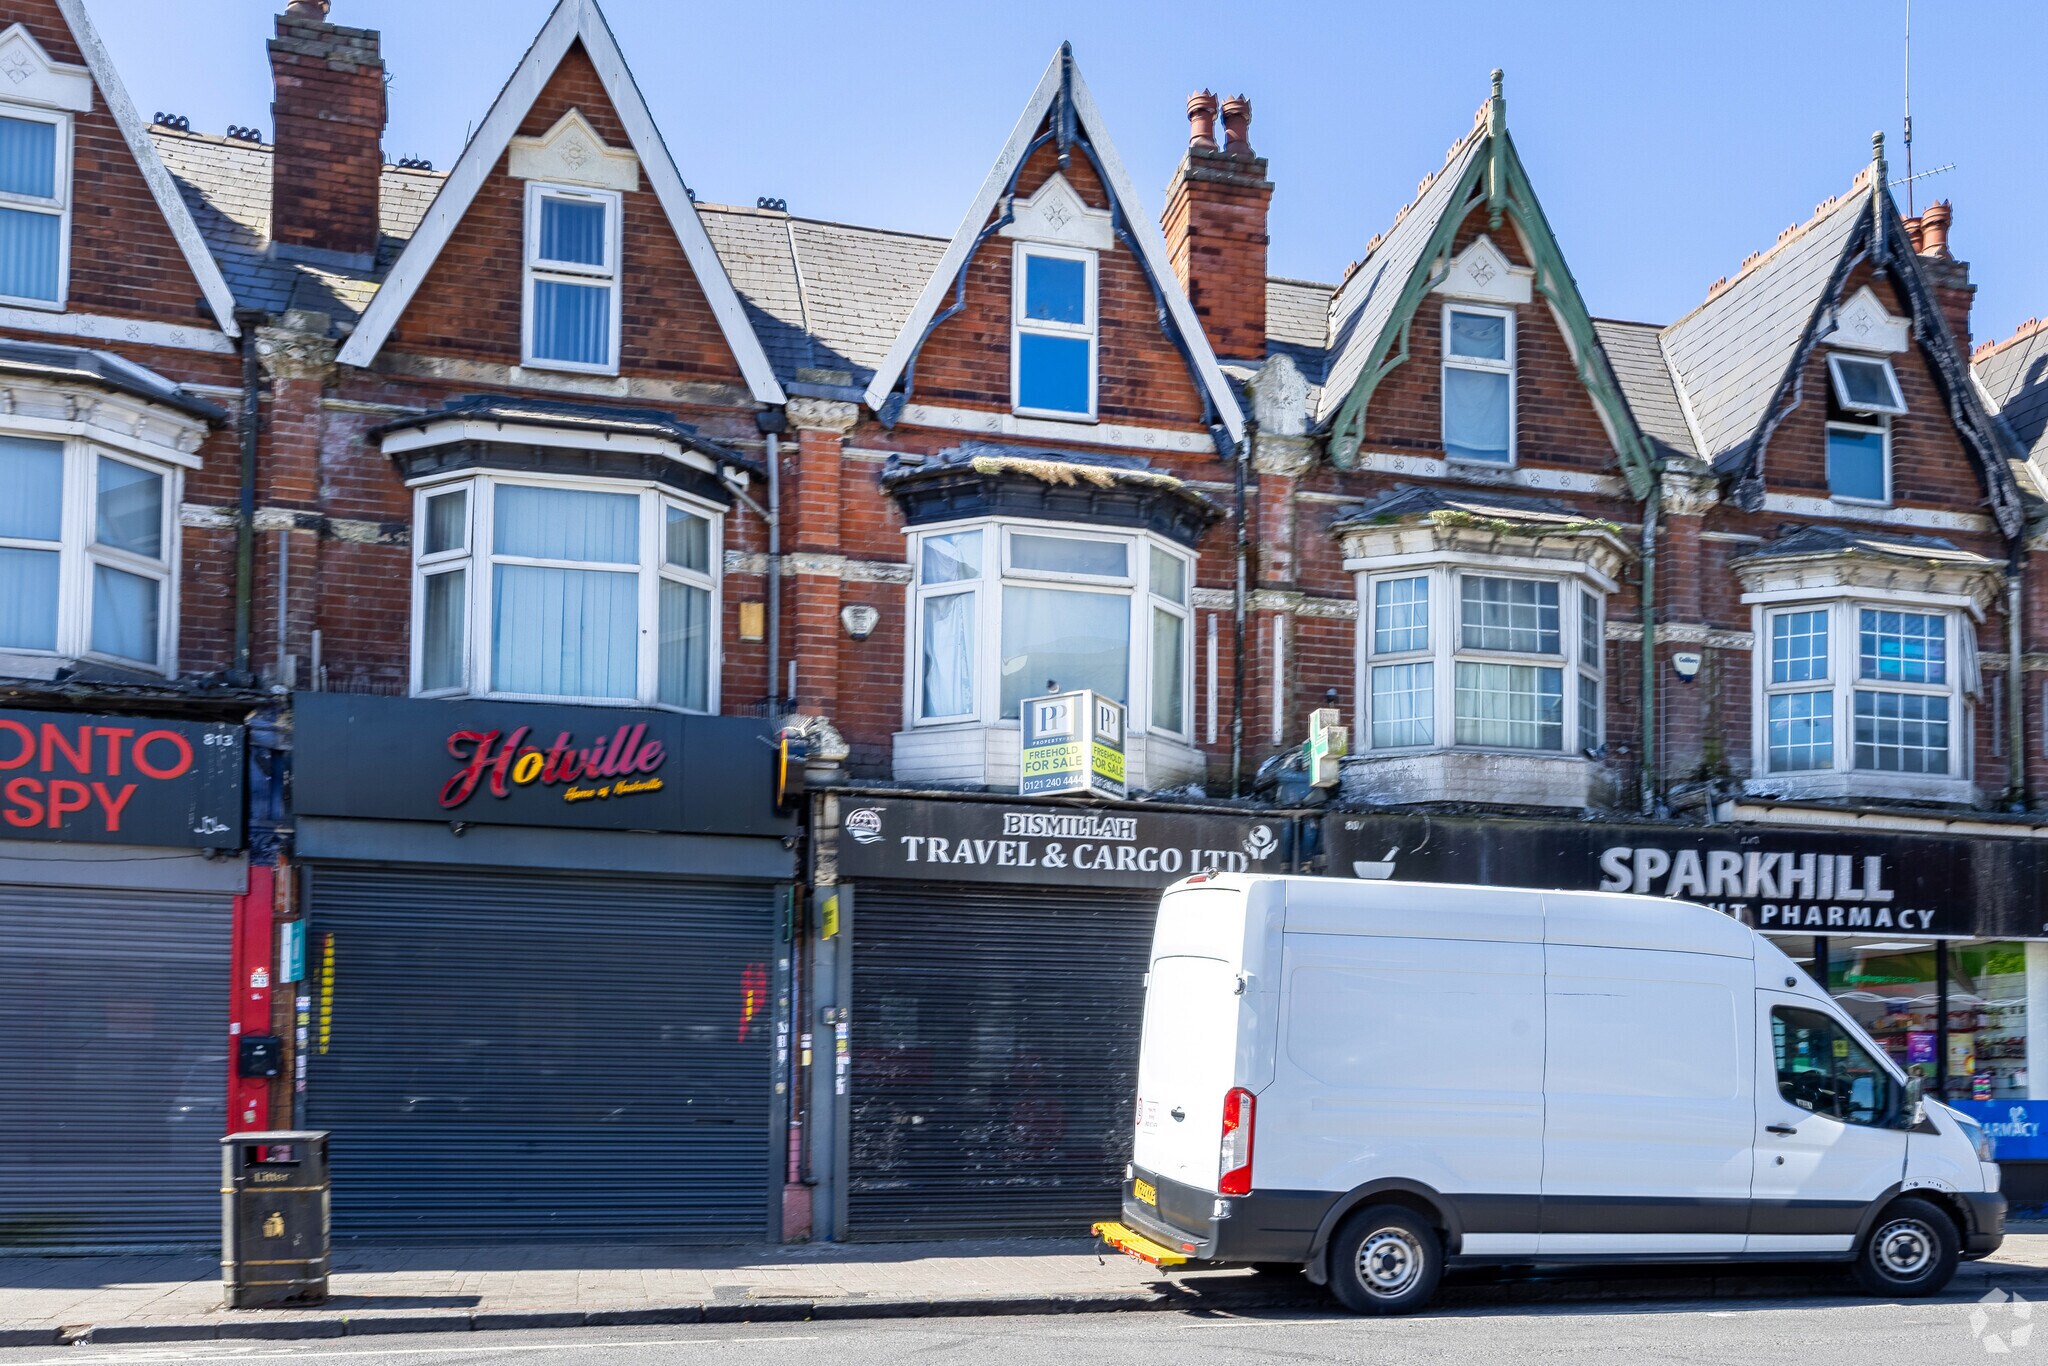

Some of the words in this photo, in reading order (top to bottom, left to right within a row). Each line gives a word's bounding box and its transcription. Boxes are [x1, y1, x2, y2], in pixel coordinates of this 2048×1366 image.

[203, 733, 234, 747] 813
[1029, 746, 1078, 760] FREEHOLD
[1093, 746, 1122, 765] FREEHOLD
[439, 723, 666, 808] Hotville
[1025, 760, 1049, 773] FOR
[1052, 755, 1083, 769] SALE
[1091, 755, 1106, 771] FOR
[1107, 761, 1124, 778] SALE
[1024, 780, 1043, 791] 0121
[1046, 777, 1062, 788] 240
[1063, 775, 1083, 786] 4444
[3, 777, 139, 832] SPY
[1003, 812, 1138, 841] BISMILLAH
[901, 835, 1037, 868] TRAVEL
[1042, 842, 1068, 869] &
[1072, 843, 1183, 874] CARGO
[1190, 849, 1249, 873] LTD
[1599, 847, 1896, 901] SPARKHILL
[1761, 904, 1936, 930] PHARMACY
[1980, 1122, 2040, 1137] ARMACY
[254, 1172, 289, 1183] Litter
